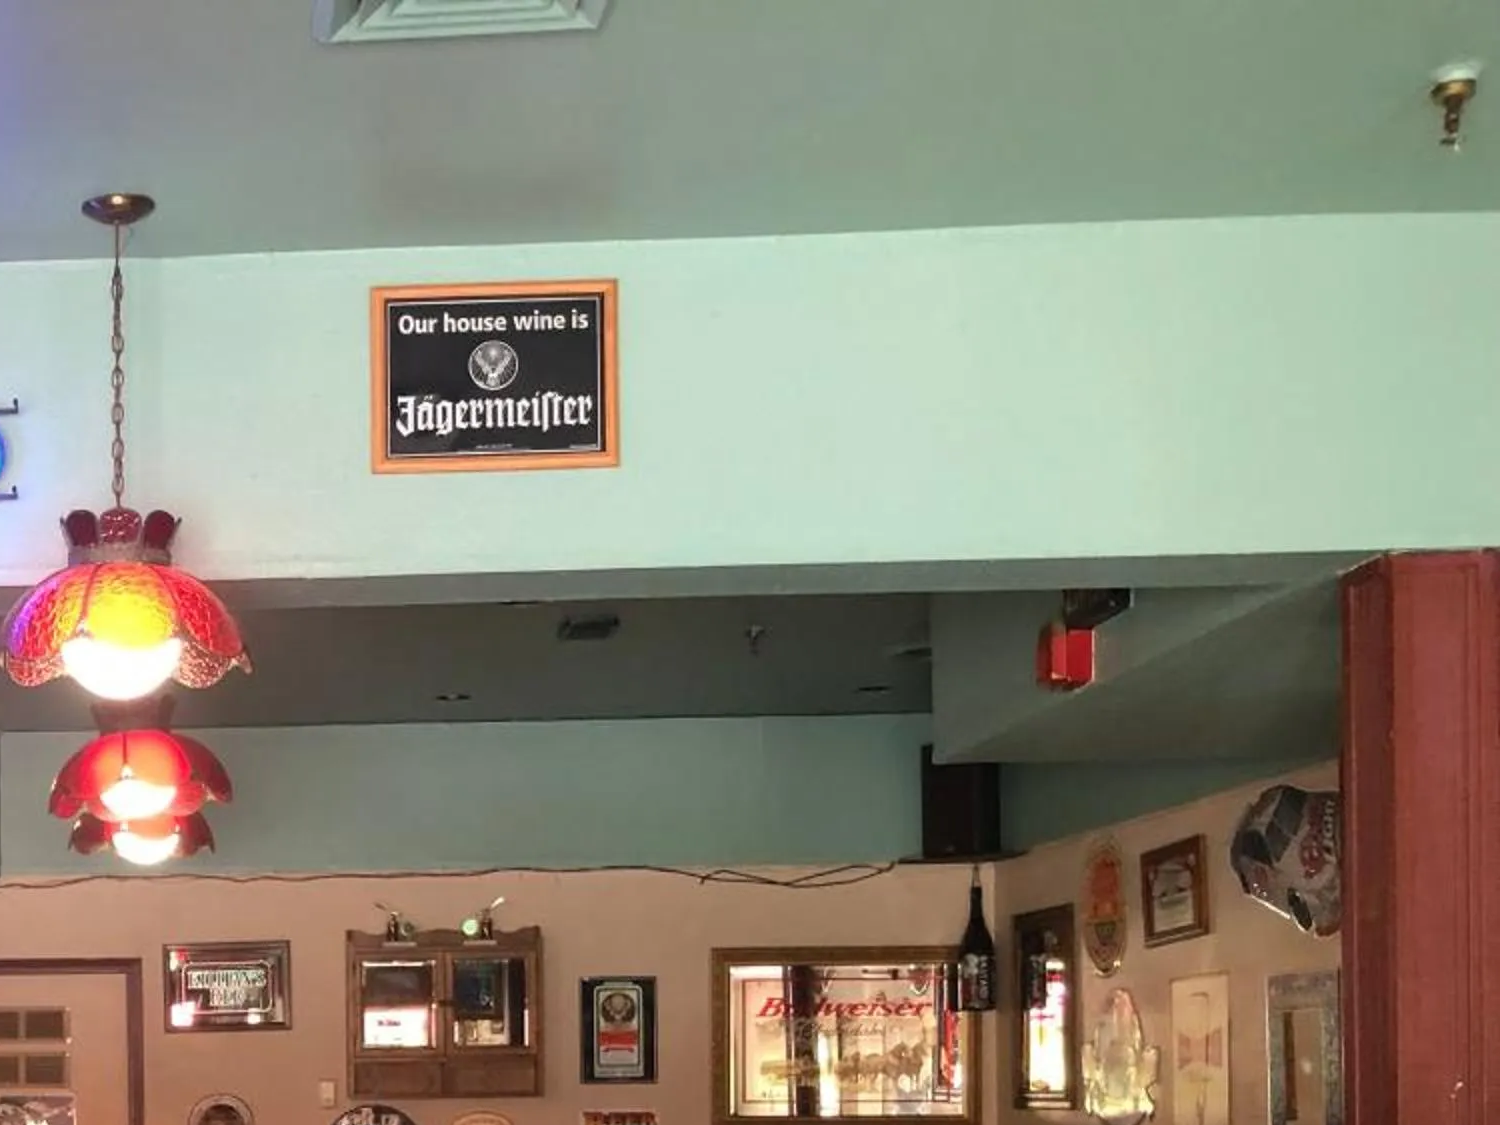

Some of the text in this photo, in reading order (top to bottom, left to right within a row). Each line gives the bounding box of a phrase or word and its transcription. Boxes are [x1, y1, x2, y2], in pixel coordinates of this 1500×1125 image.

[398, 308, 589, 335] Our house wine is
[396, 391, 593, 436] Jägermeister
[756, 997, 933, 1018] Bweiser
